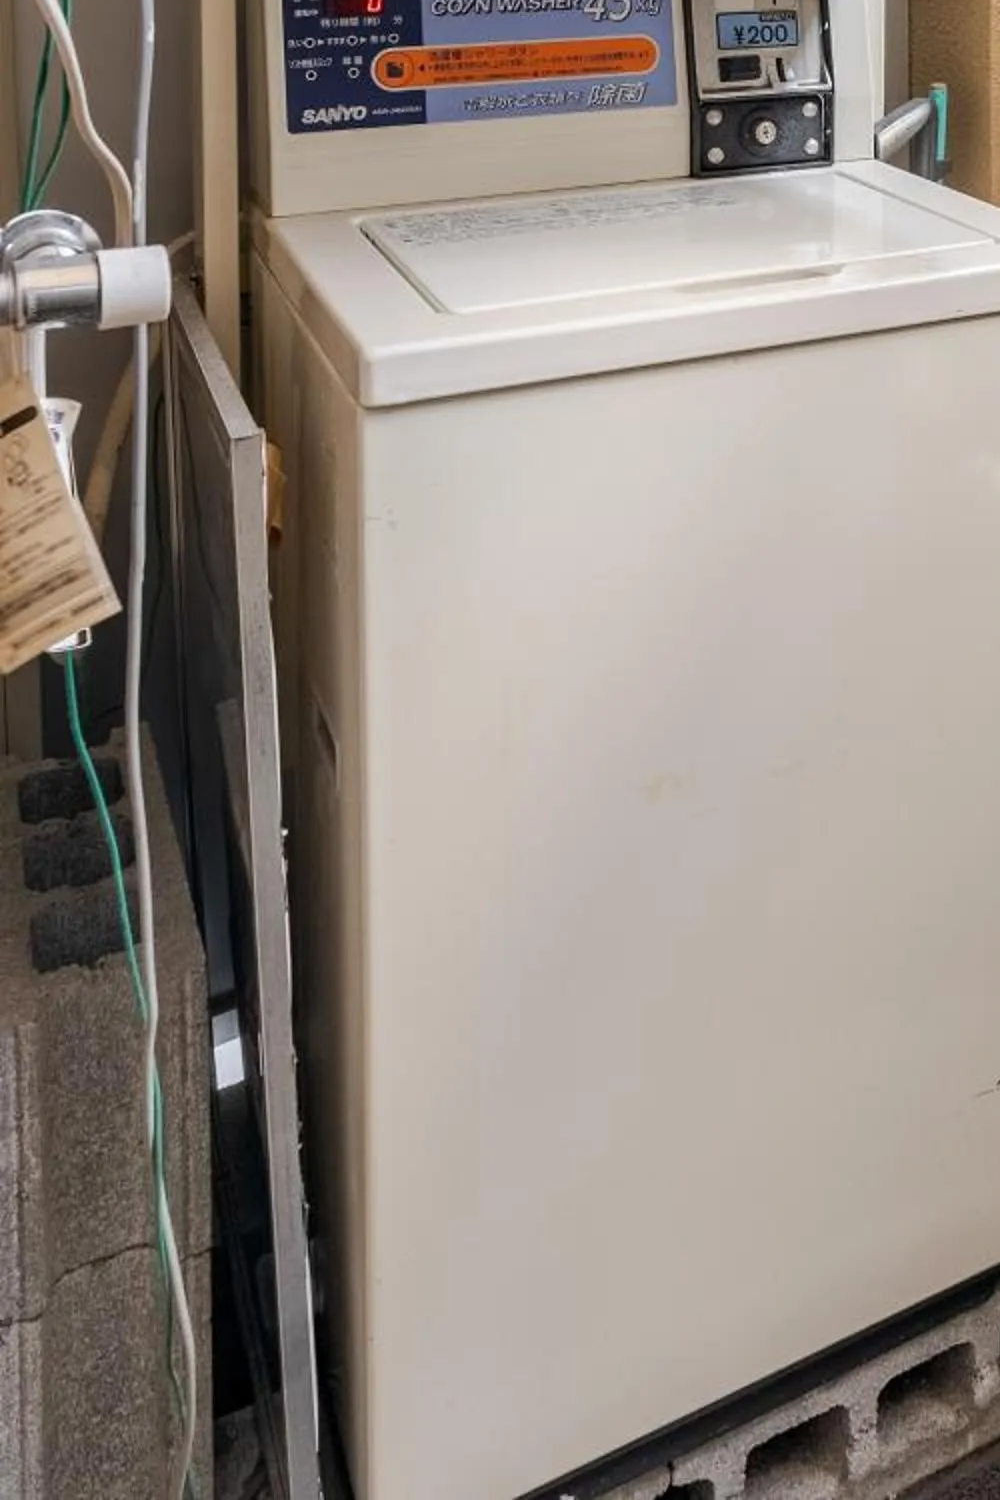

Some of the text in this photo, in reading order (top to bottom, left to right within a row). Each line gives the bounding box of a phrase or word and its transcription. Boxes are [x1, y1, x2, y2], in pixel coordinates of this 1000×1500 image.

[733, 24, 788, 45] ¥200
[587, 82, 646, 108] 除菌
[301, 105, 367, 124] SANYO
